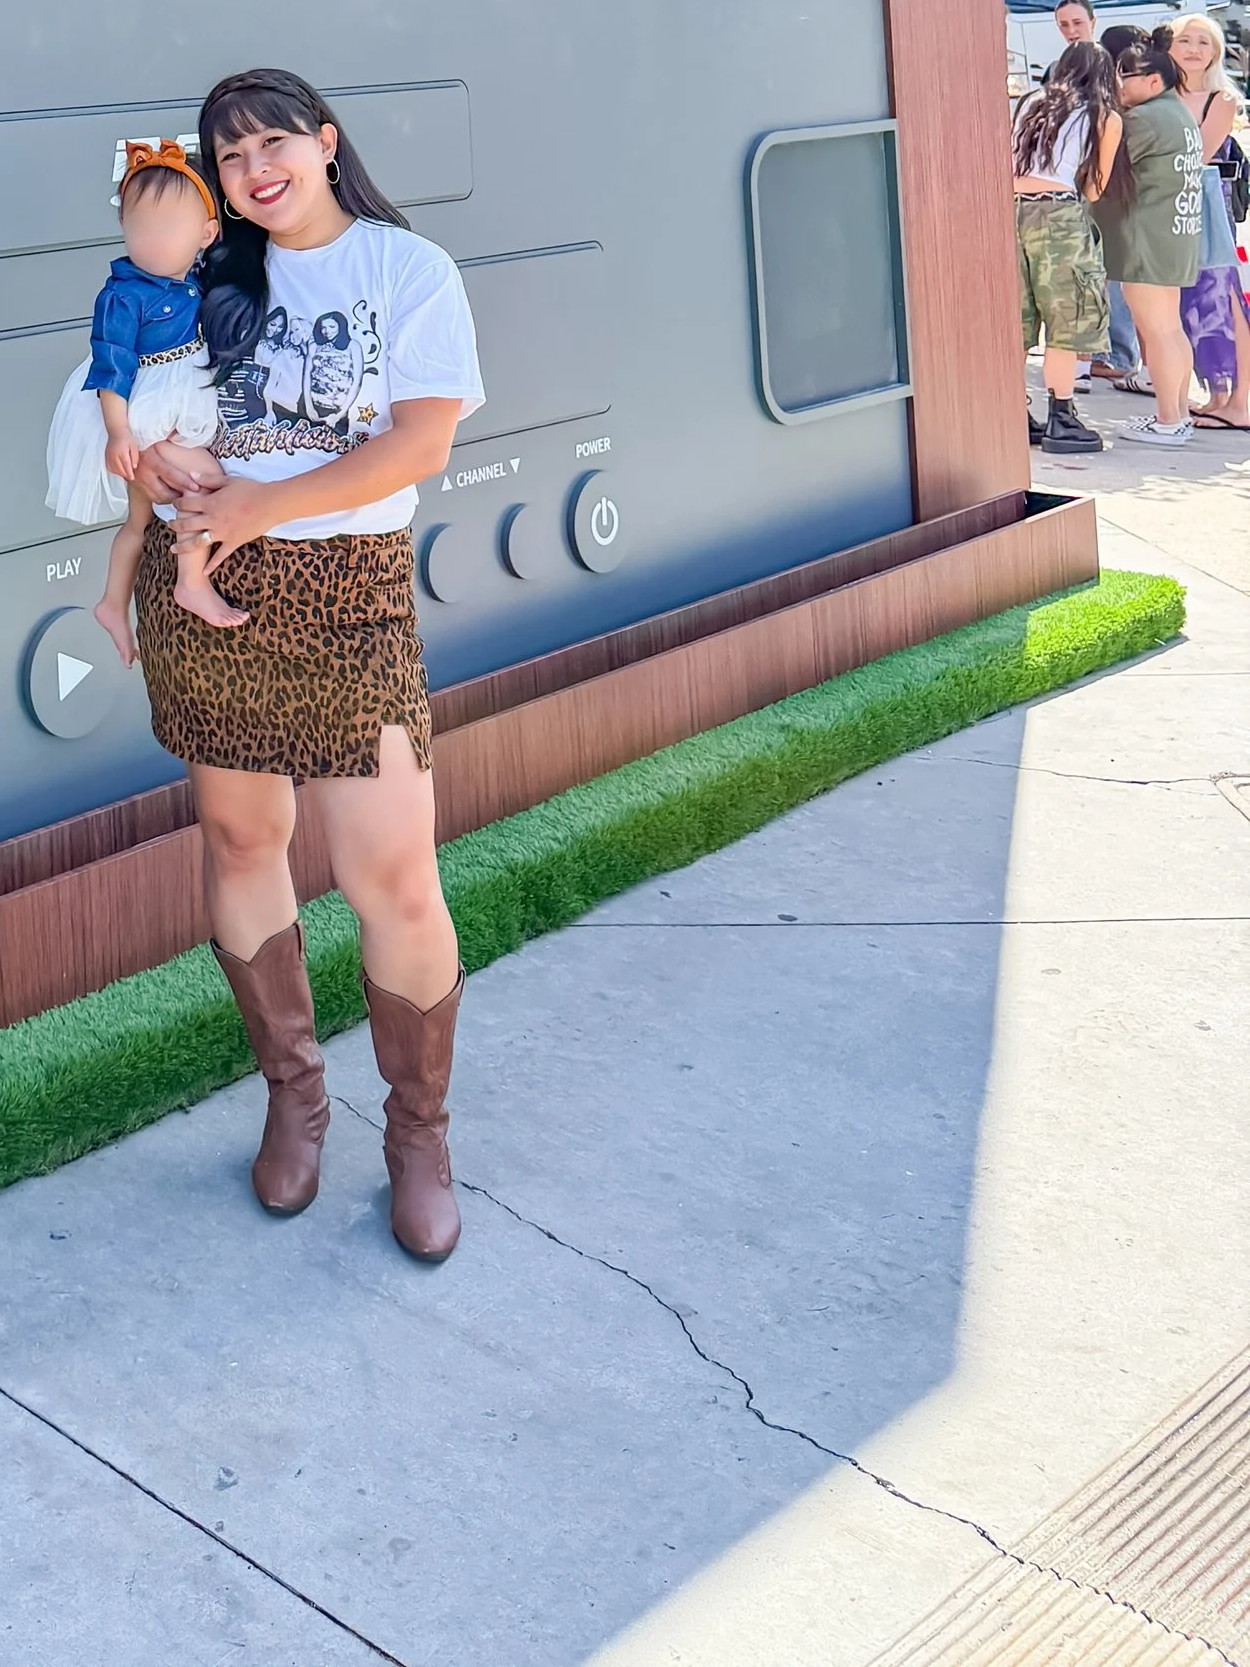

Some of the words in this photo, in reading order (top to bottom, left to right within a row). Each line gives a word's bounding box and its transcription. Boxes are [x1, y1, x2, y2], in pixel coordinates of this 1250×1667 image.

[575, 437, 612, 459] POWER
[456, 462, 507, 488] CHANNEL
[46, 557, 82, 582] PLAY
